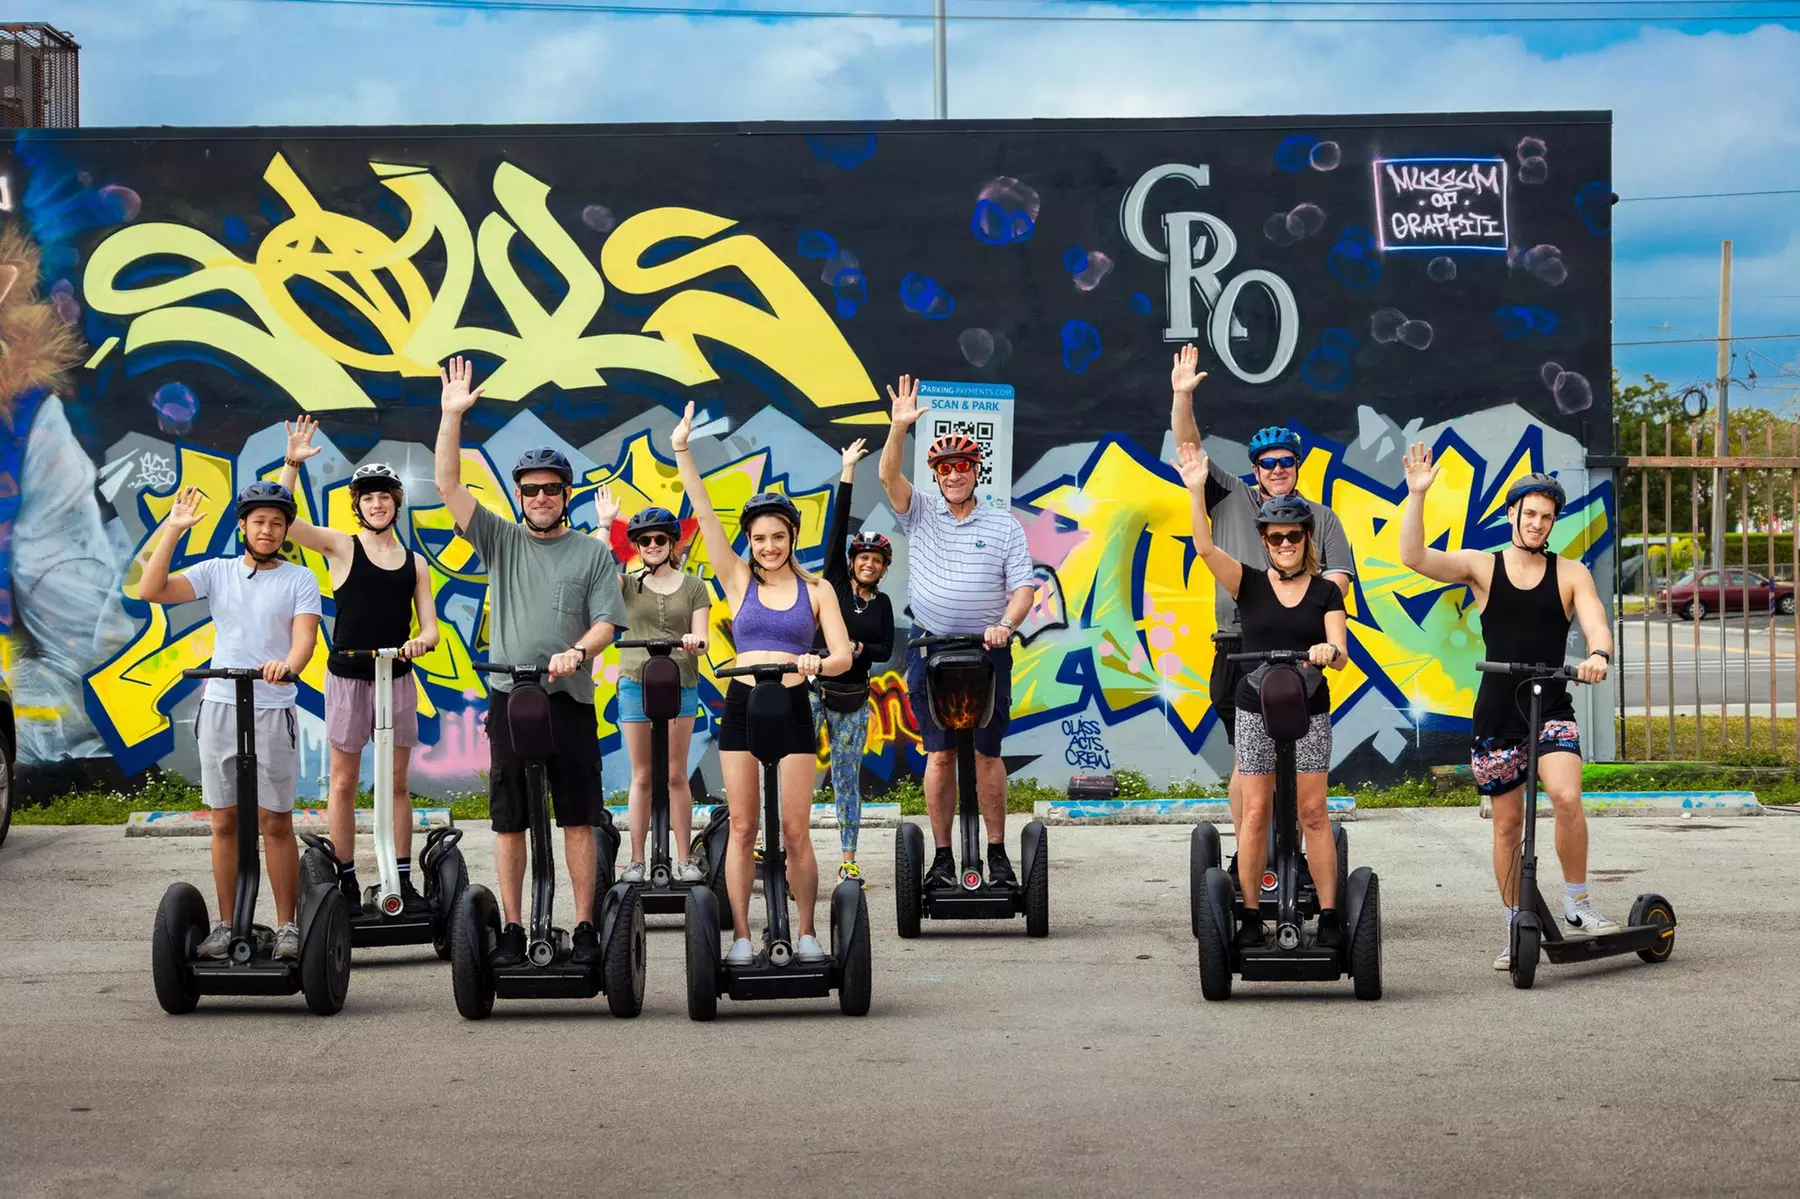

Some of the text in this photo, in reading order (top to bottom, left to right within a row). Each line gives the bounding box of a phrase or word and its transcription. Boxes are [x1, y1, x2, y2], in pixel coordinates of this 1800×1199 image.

[1386, 163, 1500, 195] MUSEUM
[1431, 191, 1457, 211] OF
[1391, 212, 1504, 239] GRAFFITI
[931, 400, 999, 411] SCAN & PARK
[1069, 735, 1104, 751] ACTS
[1065, 749, 1111, 770] CREW
